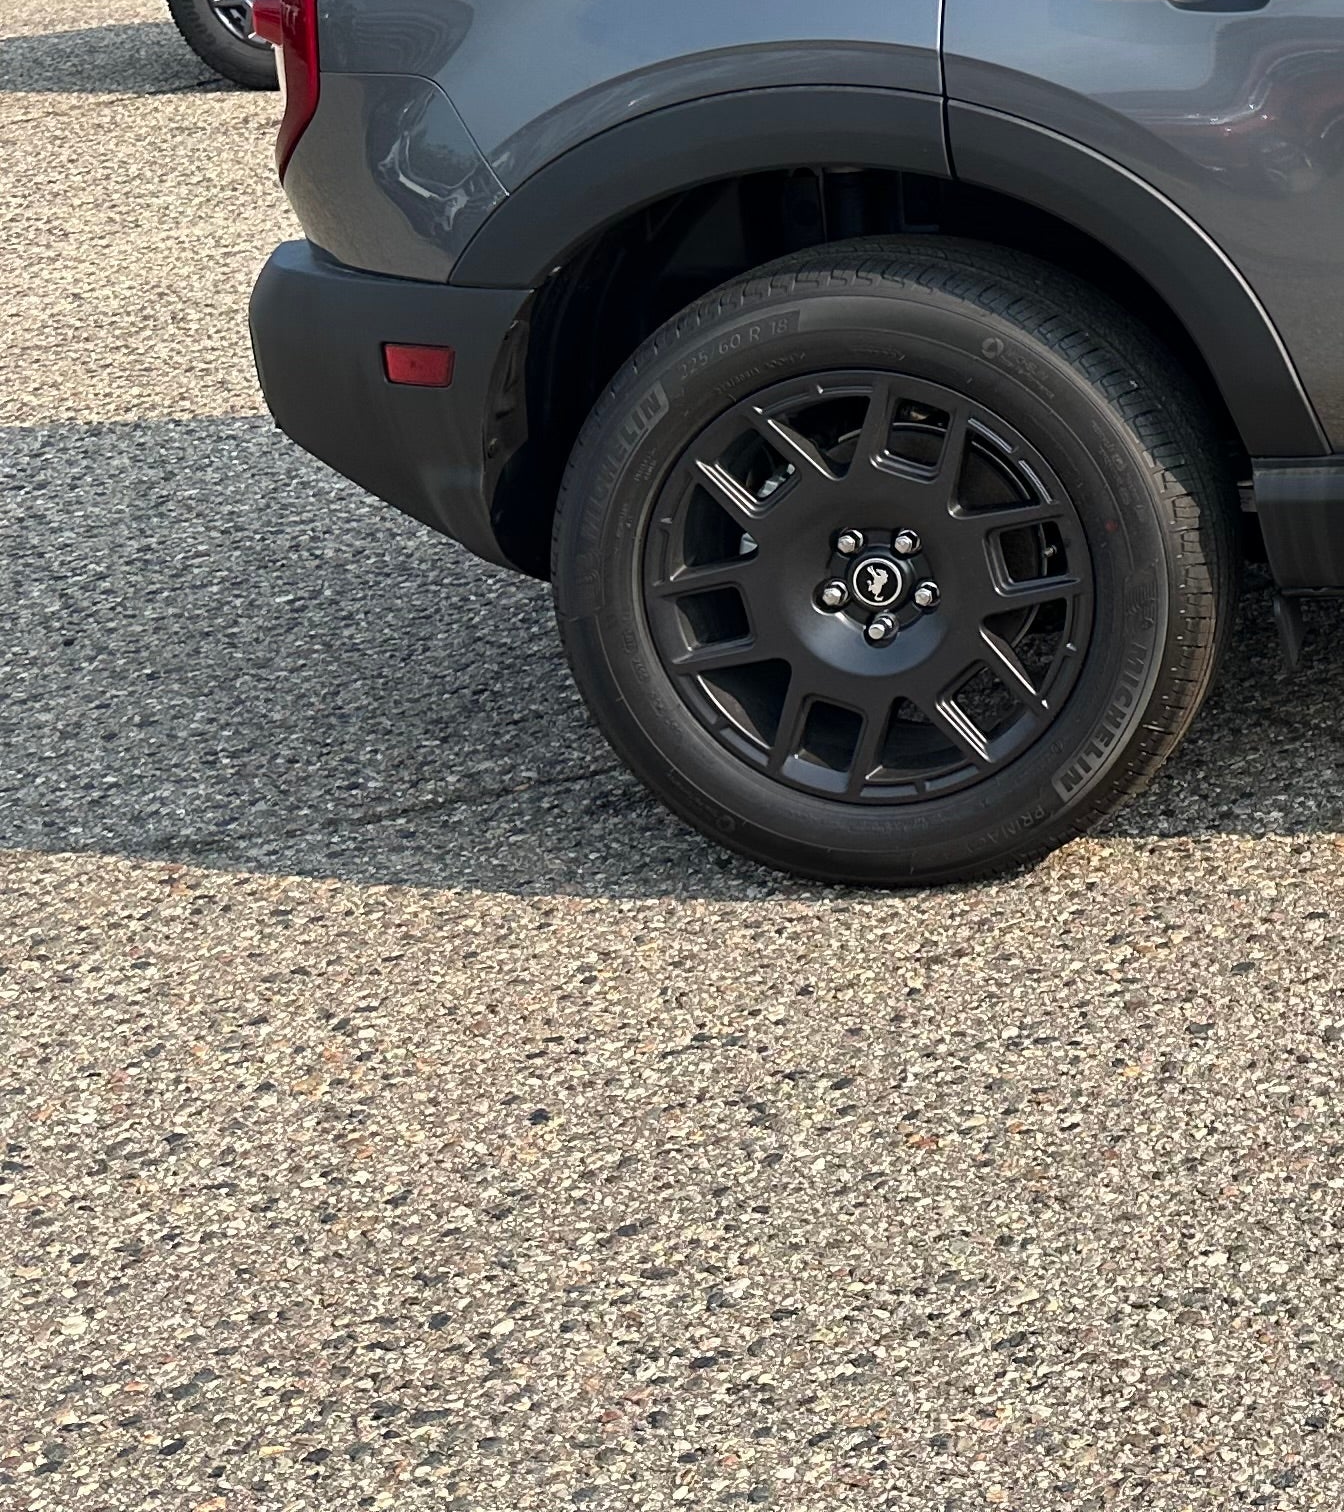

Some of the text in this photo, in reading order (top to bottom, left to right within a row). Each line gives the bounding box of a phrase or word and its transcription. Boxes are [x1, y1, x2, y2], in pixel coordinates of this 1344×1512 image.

[677, 331, 743, 378] 225/60
[745, 325, 764, 344] R
[767, 316, 789, 336] 18
[579, 392, 663, 545] MICHELIN
[1057, 640, 1147, 793] MICHELIN
